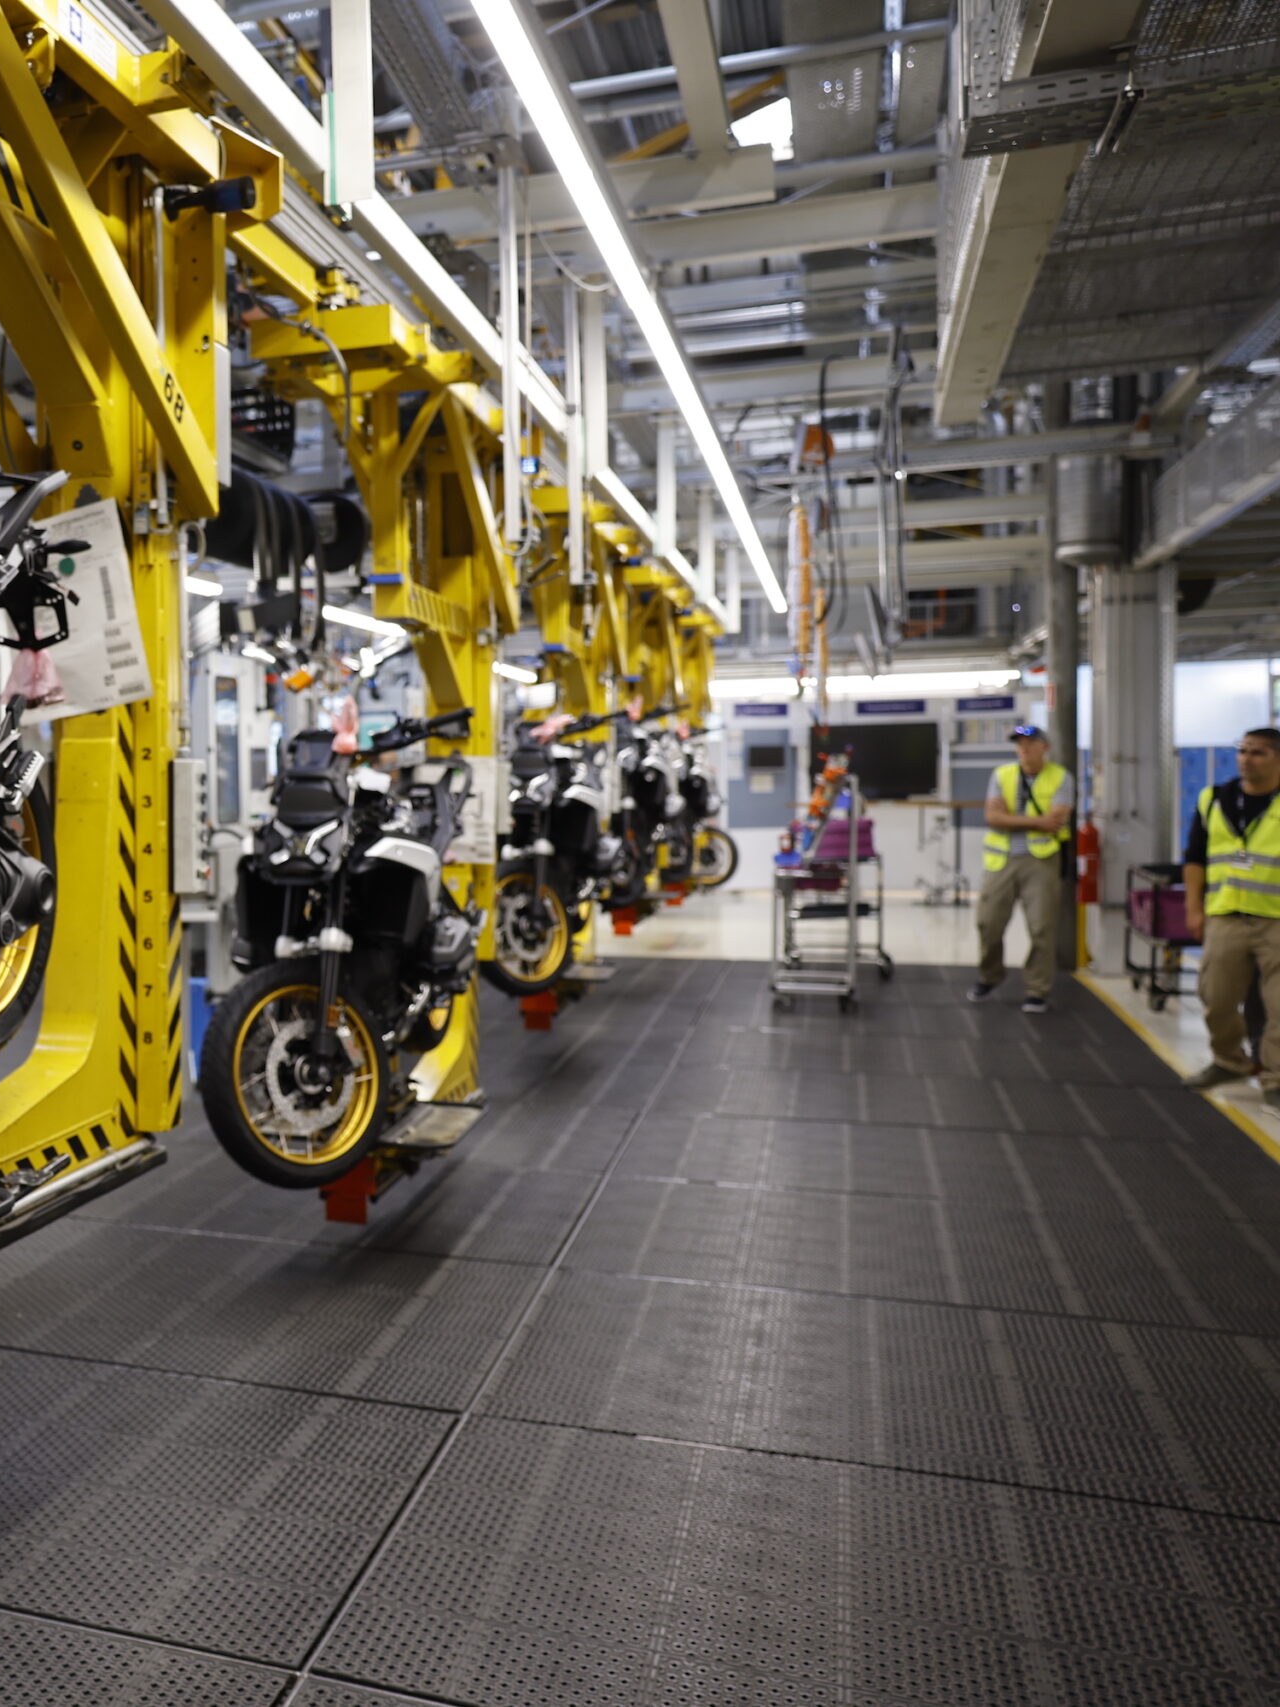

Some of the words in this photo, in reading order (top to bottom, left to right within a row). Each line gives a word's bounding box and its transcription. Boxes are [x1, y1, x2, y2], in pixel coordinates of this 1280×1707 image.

[142, 700, 150, 712] 1
[142, 748, 151, 760] 2
[142, 796, 151, 808] 3
[142, 843, 152, 855] 4
[143, 890, 153, 903] 5
[143, 938, 153, 950] 6
[143, 984, 153, 997] 7
[143, 1031, 153, 1044] 8
